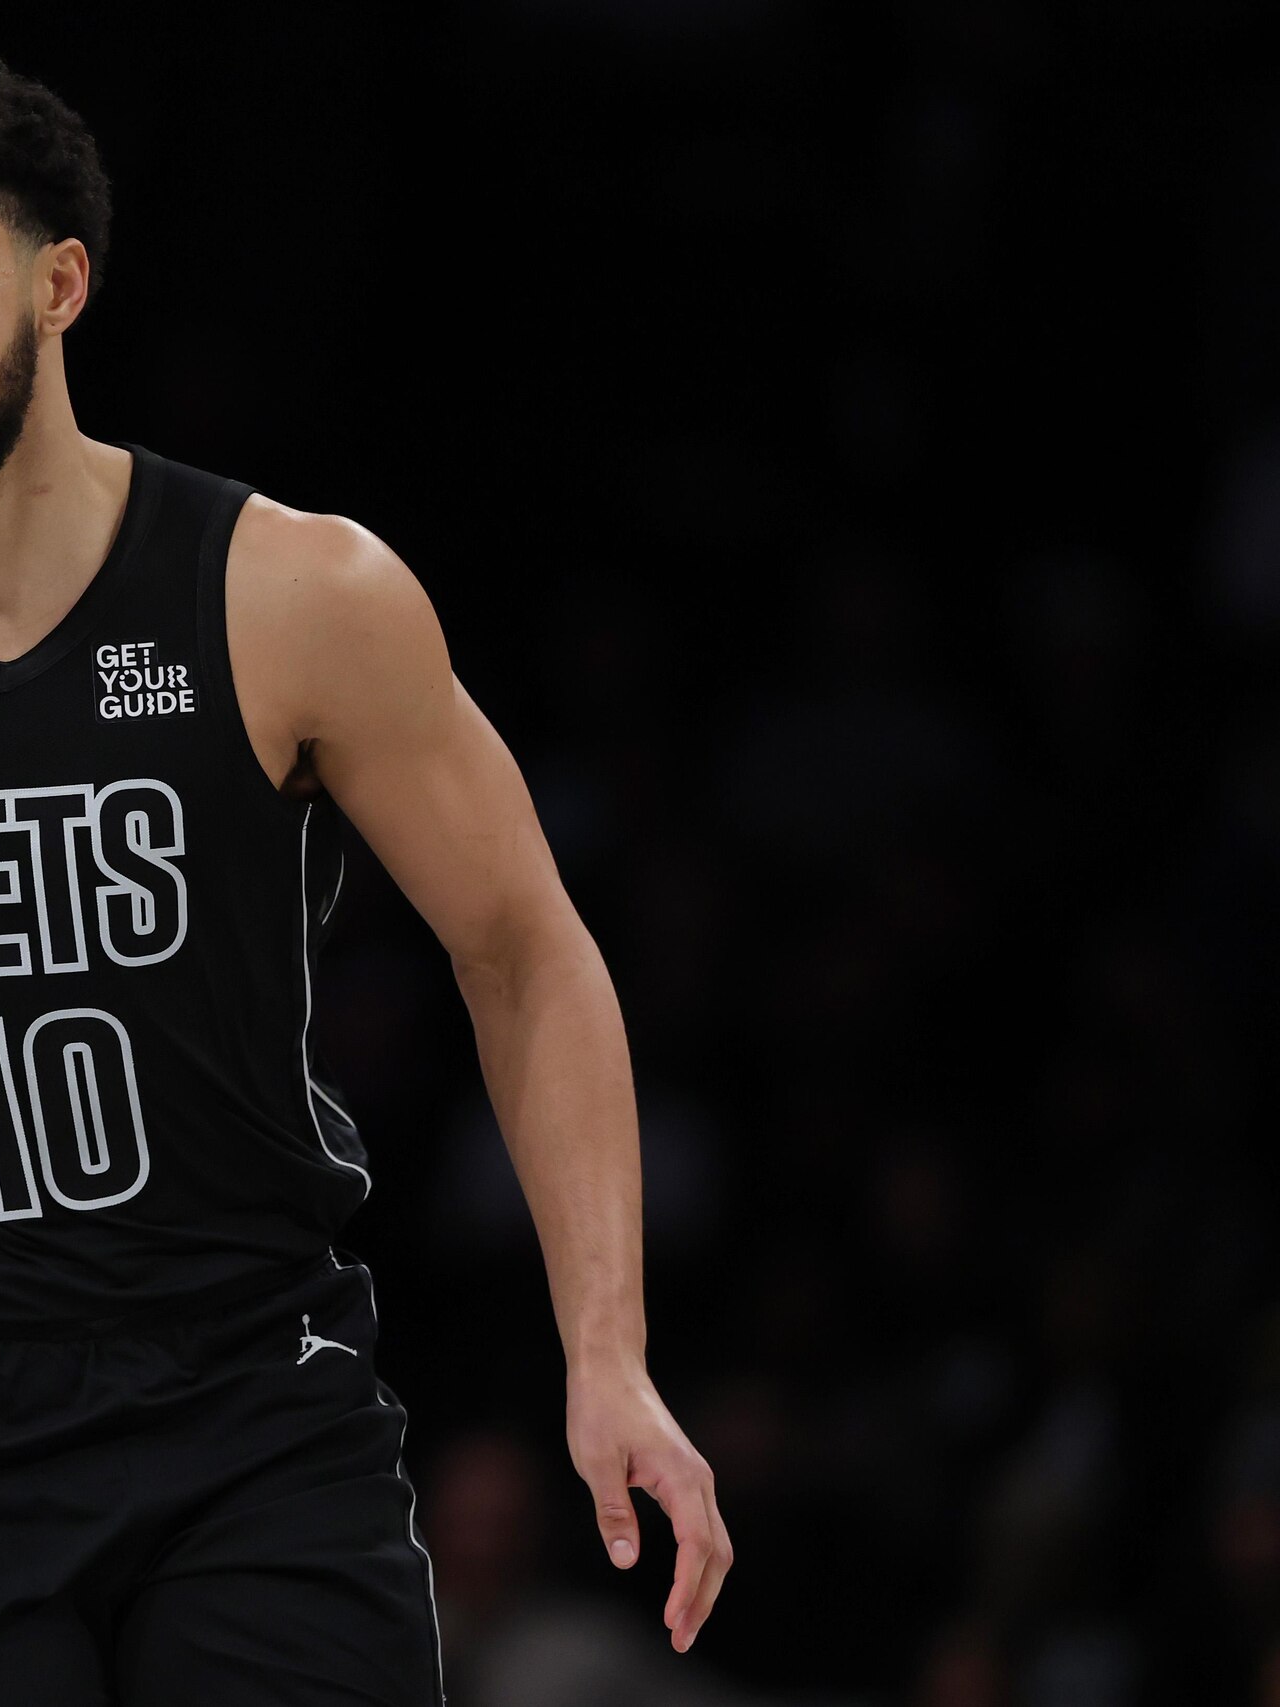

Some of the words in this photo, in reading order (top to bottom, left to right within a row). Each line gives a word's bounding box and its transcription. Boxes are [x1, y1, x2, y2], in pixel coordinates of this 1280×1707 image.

[96, 642, 155, 668] GET
[98, 665, 188, 693] YOUR
[100, 690, 195, 719] GUIDE
